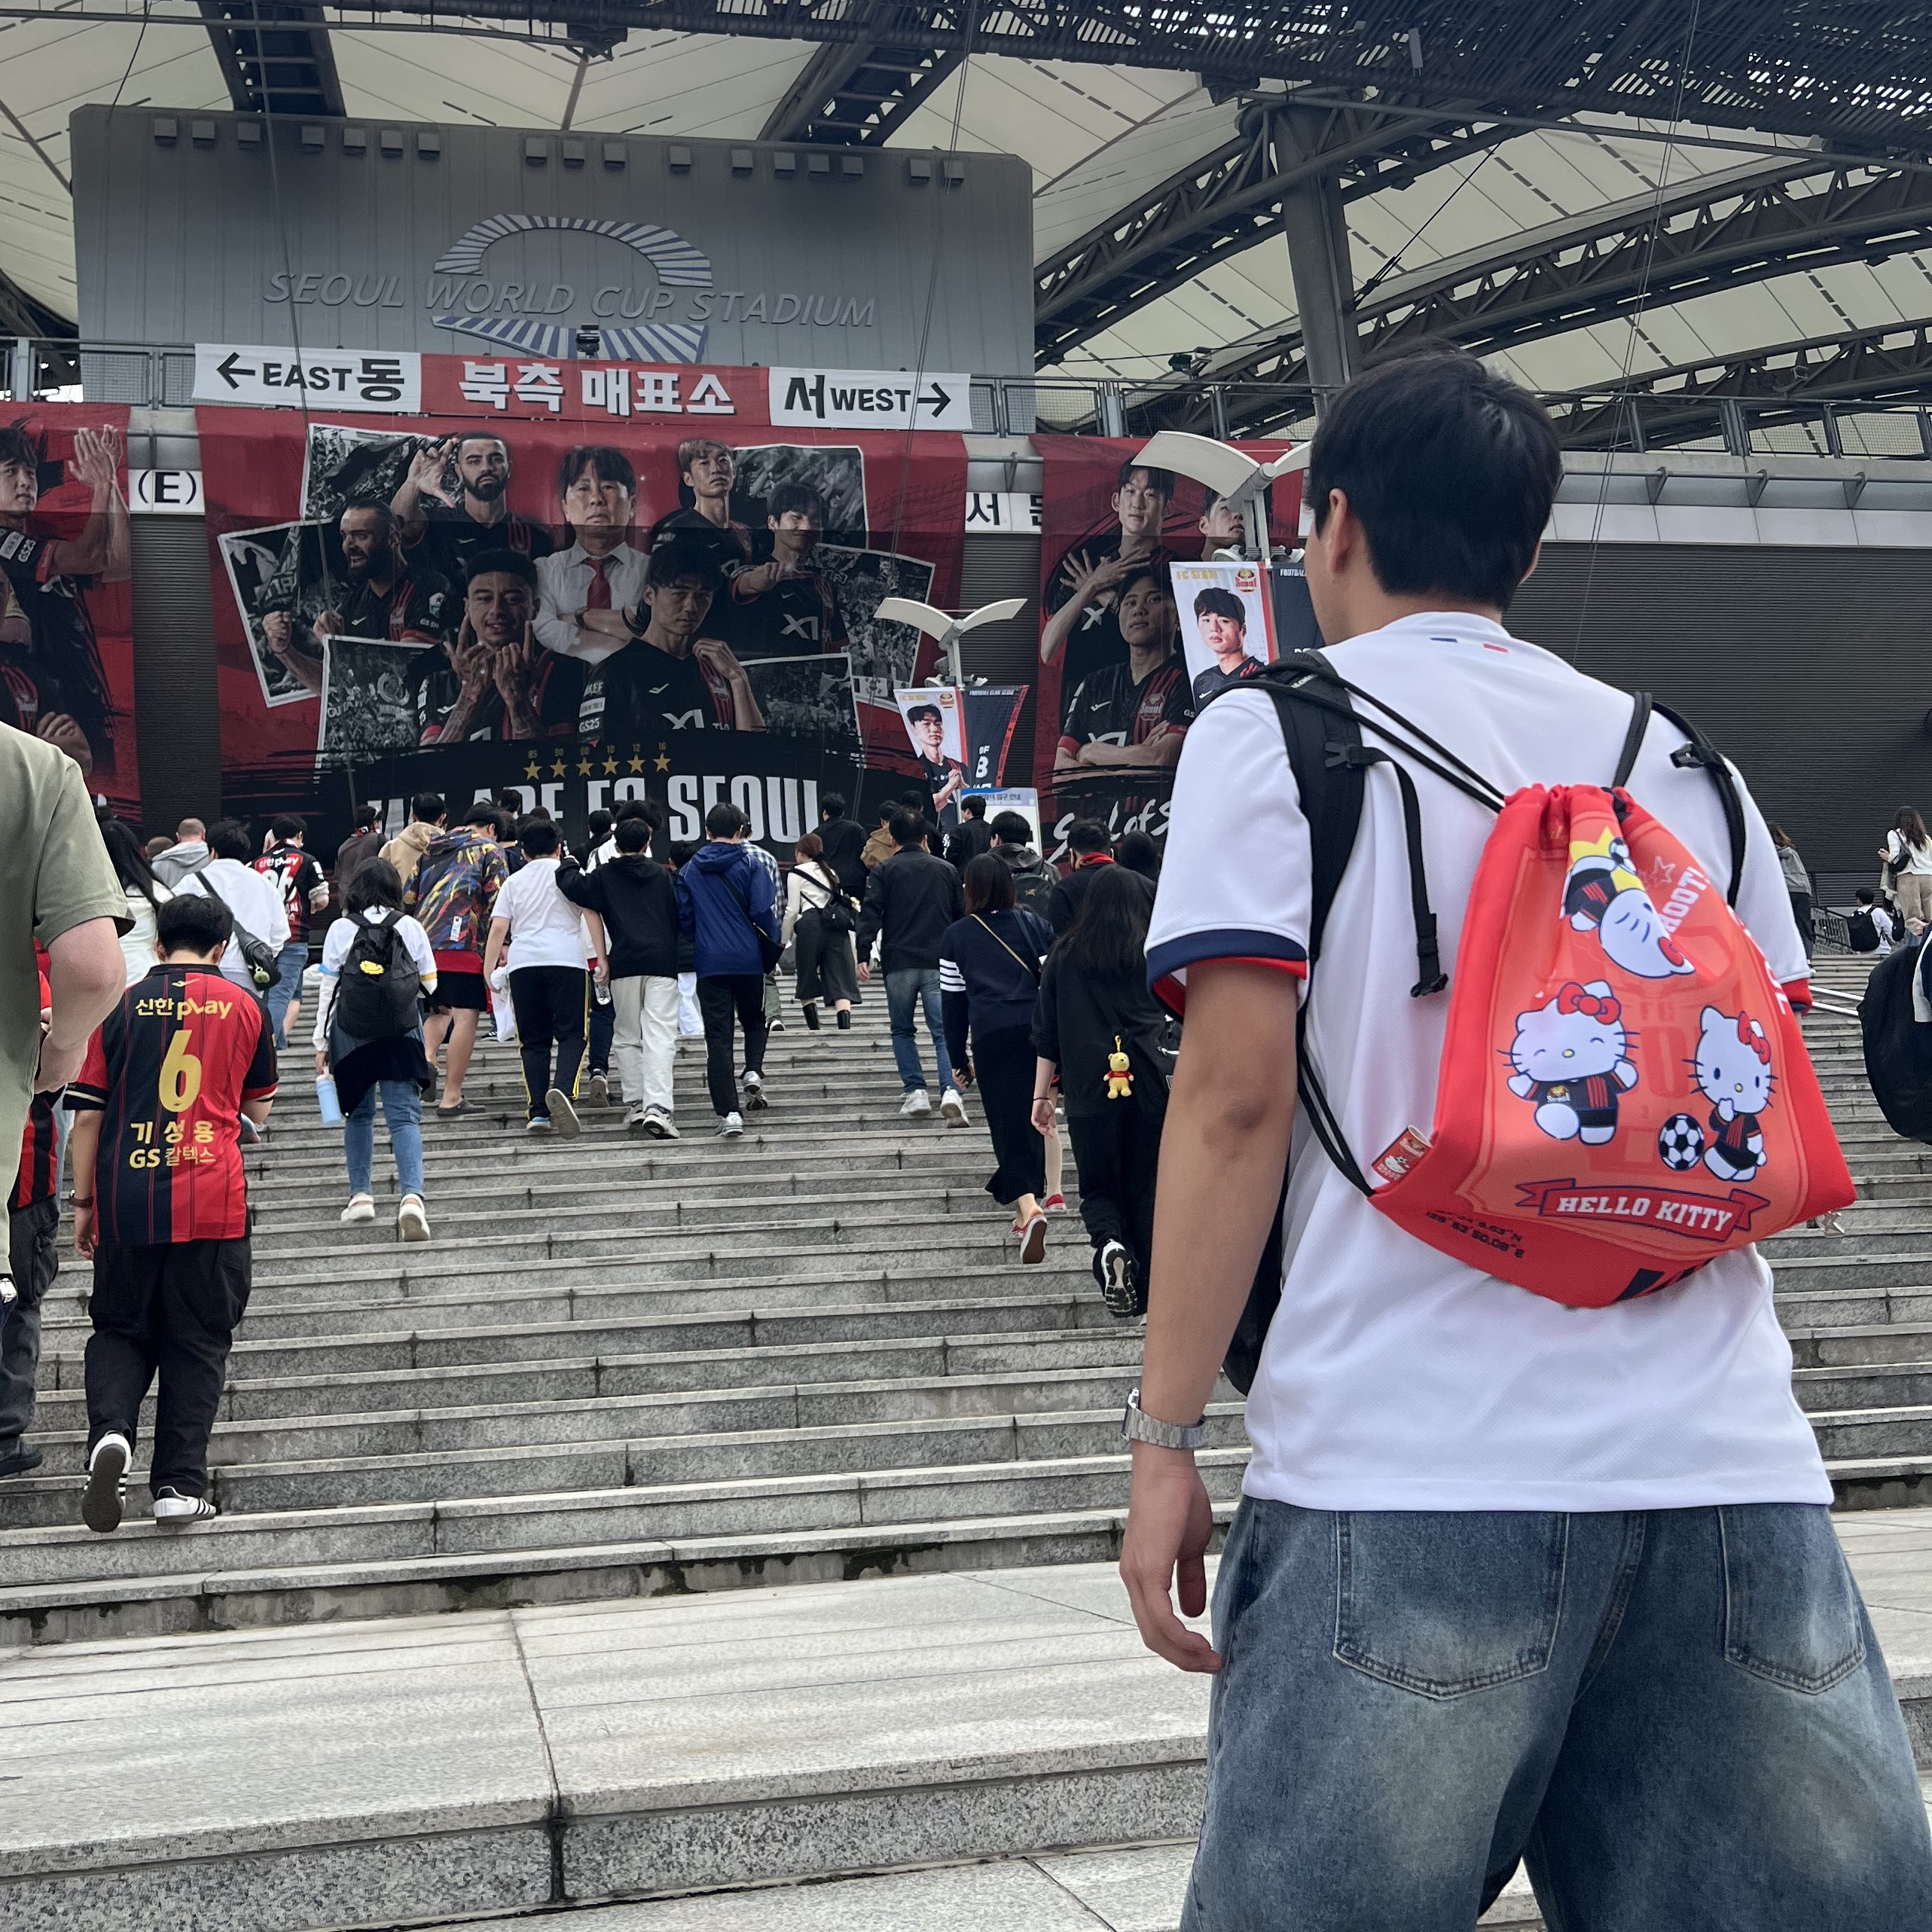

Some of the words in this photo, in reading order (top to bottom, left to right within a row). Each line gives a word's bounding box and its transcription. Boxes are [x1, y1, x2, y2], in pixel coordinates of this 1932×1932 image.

[263, 272, 404, 308] SEOUL
[425, 277, 575, 315] WORLD
[591, 286, 676, 319] CUP
[687, 291, 875, 327] STADIUM
[459, 361, 563, 412] 북측
[581, 368, 735, 417] 매표소
[138, 470, 197, 505] (E)
[1280, 569, 1307, 577] FOOTBAL
[1658, 866, 1711, 933] HOOT!
[158, 1030, 202, 1113] 6
[1556, 1196, 1651, 1216] HELLO
[1655, 1201, 1732, 1232] KITTY
